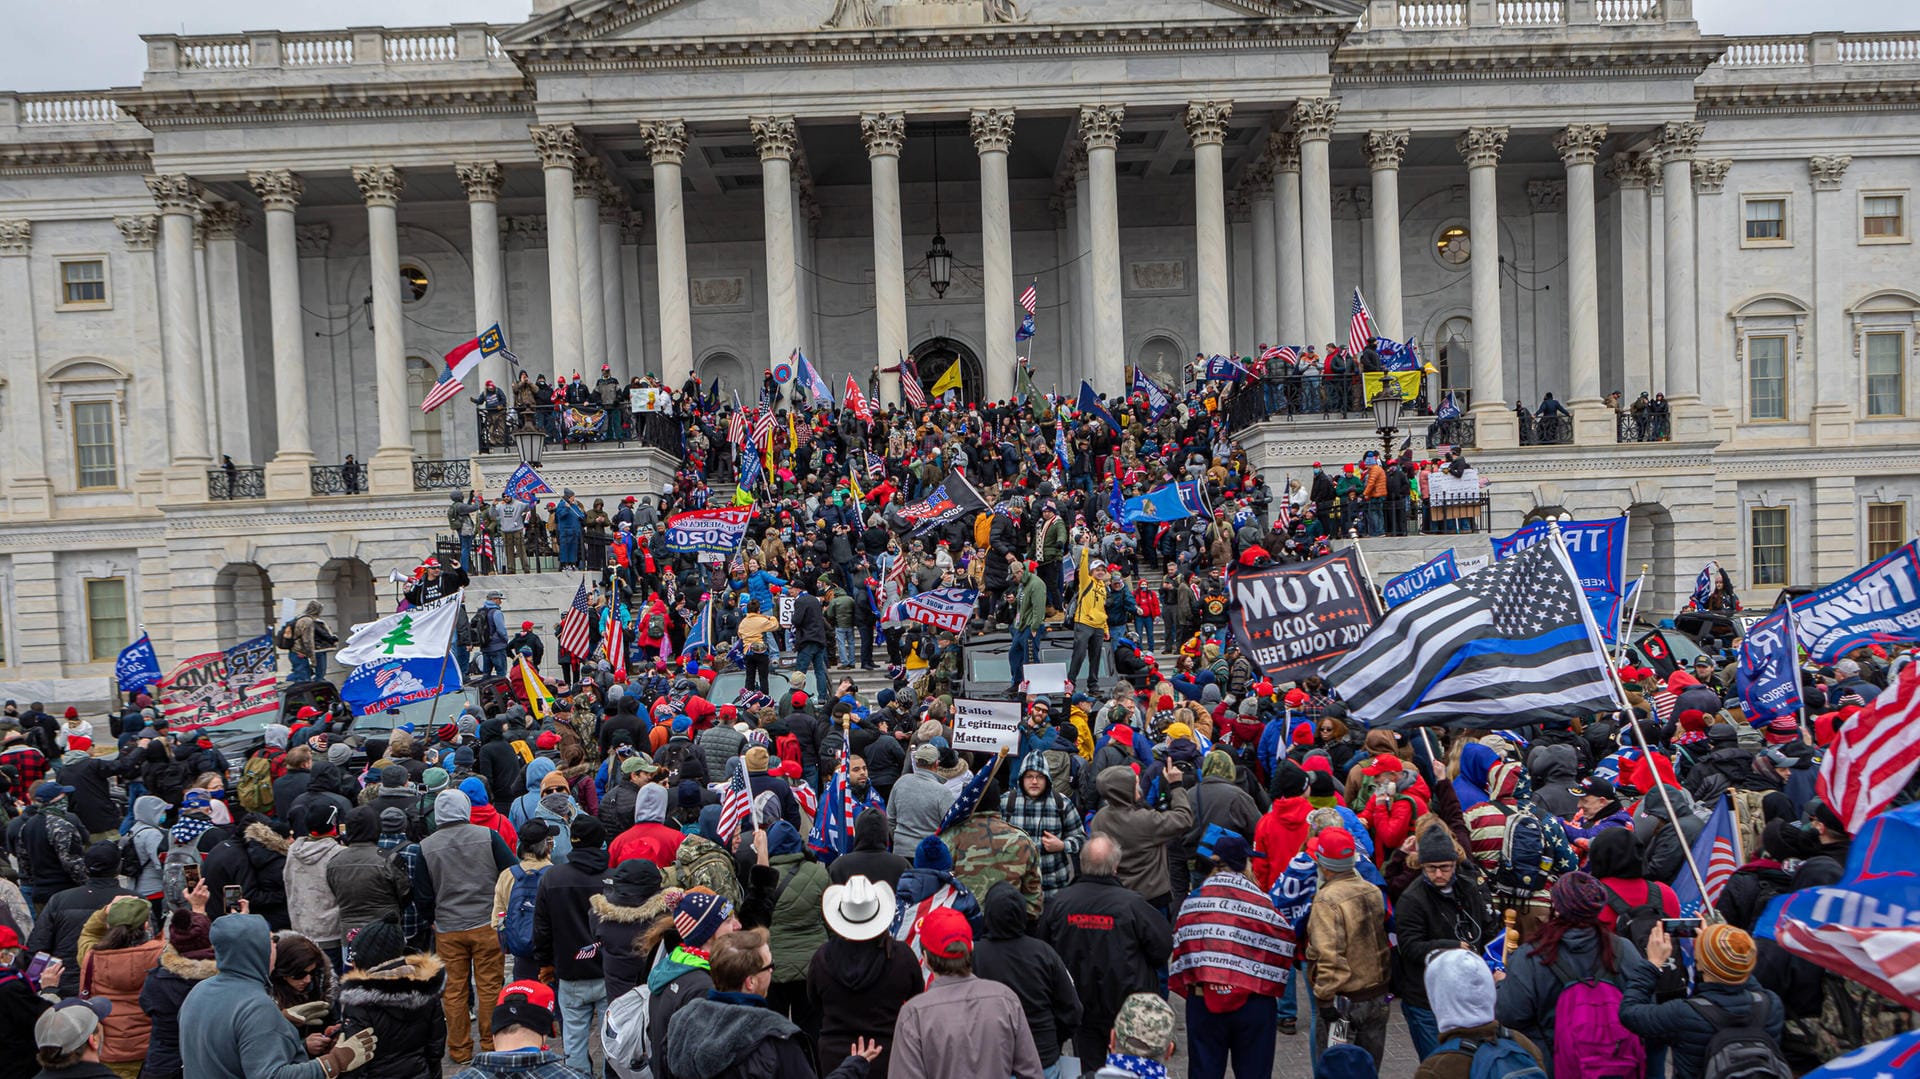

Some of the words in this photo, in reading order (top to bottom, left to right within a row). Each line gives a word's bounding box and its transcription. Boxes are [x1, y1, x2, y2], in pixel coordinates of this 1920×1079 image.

[958, 705, 993, 717] Ballot
[957, 717, 1018, 733] Legitimacy
[954, 731, 998, 744] Matters
[1232, 903, 1263, 916] status
[1215, 926, 1226, 936] to
[1229, 930, 1257, 943] abuse
